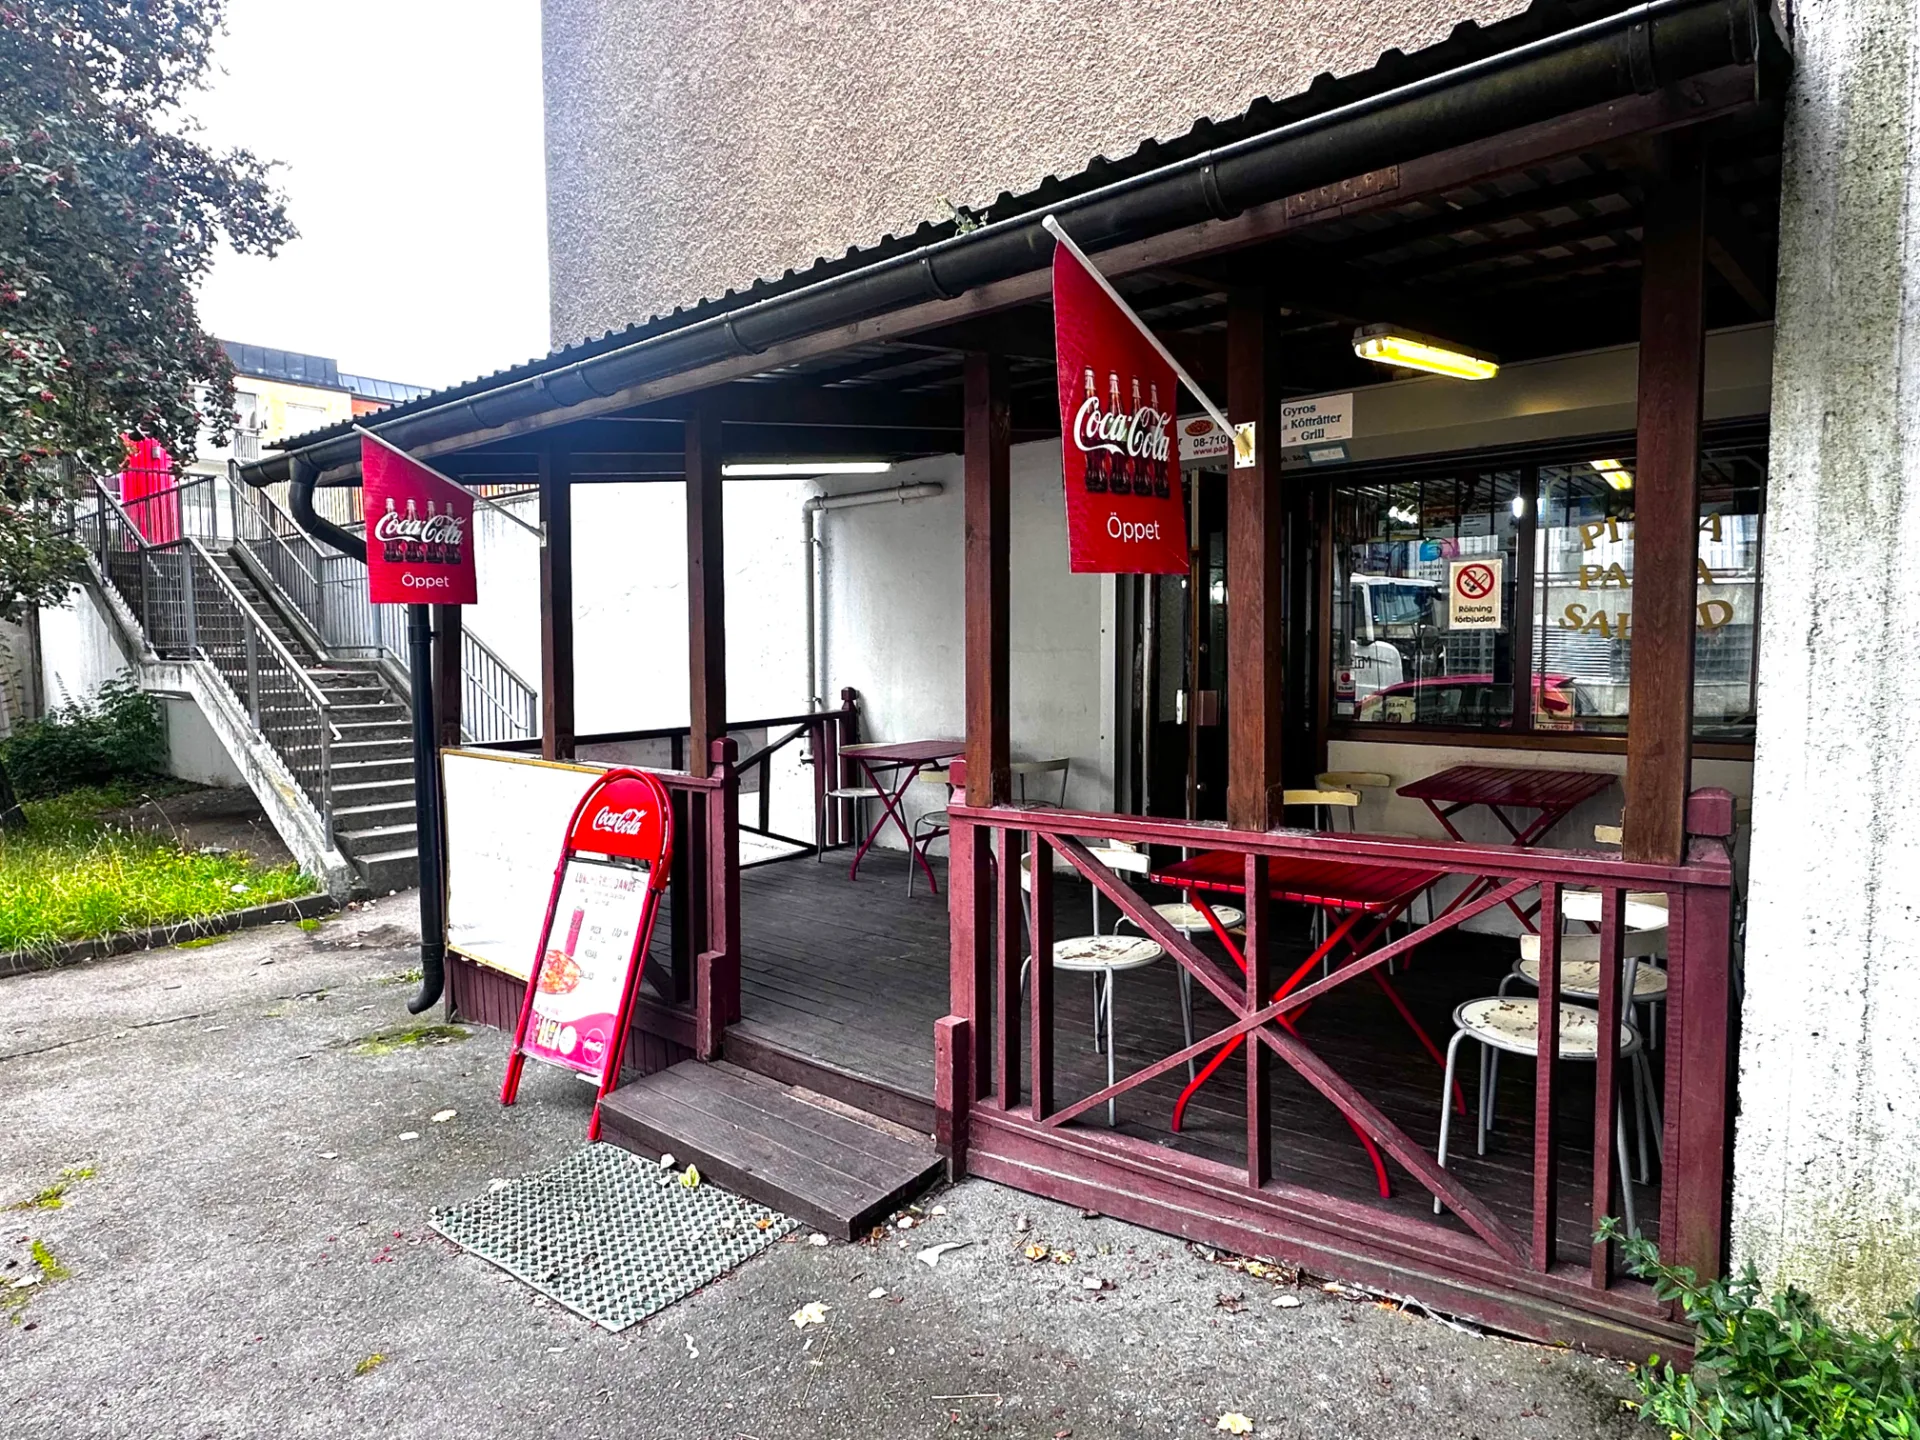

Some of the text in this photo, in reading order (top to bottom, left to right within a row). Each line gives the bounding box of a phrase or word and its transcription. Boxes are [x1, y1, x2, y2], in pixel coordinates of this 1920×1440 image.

[1282, 404, 1316, 417] Gyros
[1073, 396, 1172, 462] Coca-Cola
[1290, 413, 1342, 429] Kötträtter
[1300, 428, 1325, 441] Grill
[374, 511, 467, 545] Coca-Cola
[1106, 511, 1161, 543] Öppet
[1579, 512, 1722, 551] PIA
[401, 571, 450, 589] Öppet
[1458, 605, 1492, 614] Rökning
[1454, 615, 1496, 624] förbjuden
[1558, 599, 1734, 639] SALD
